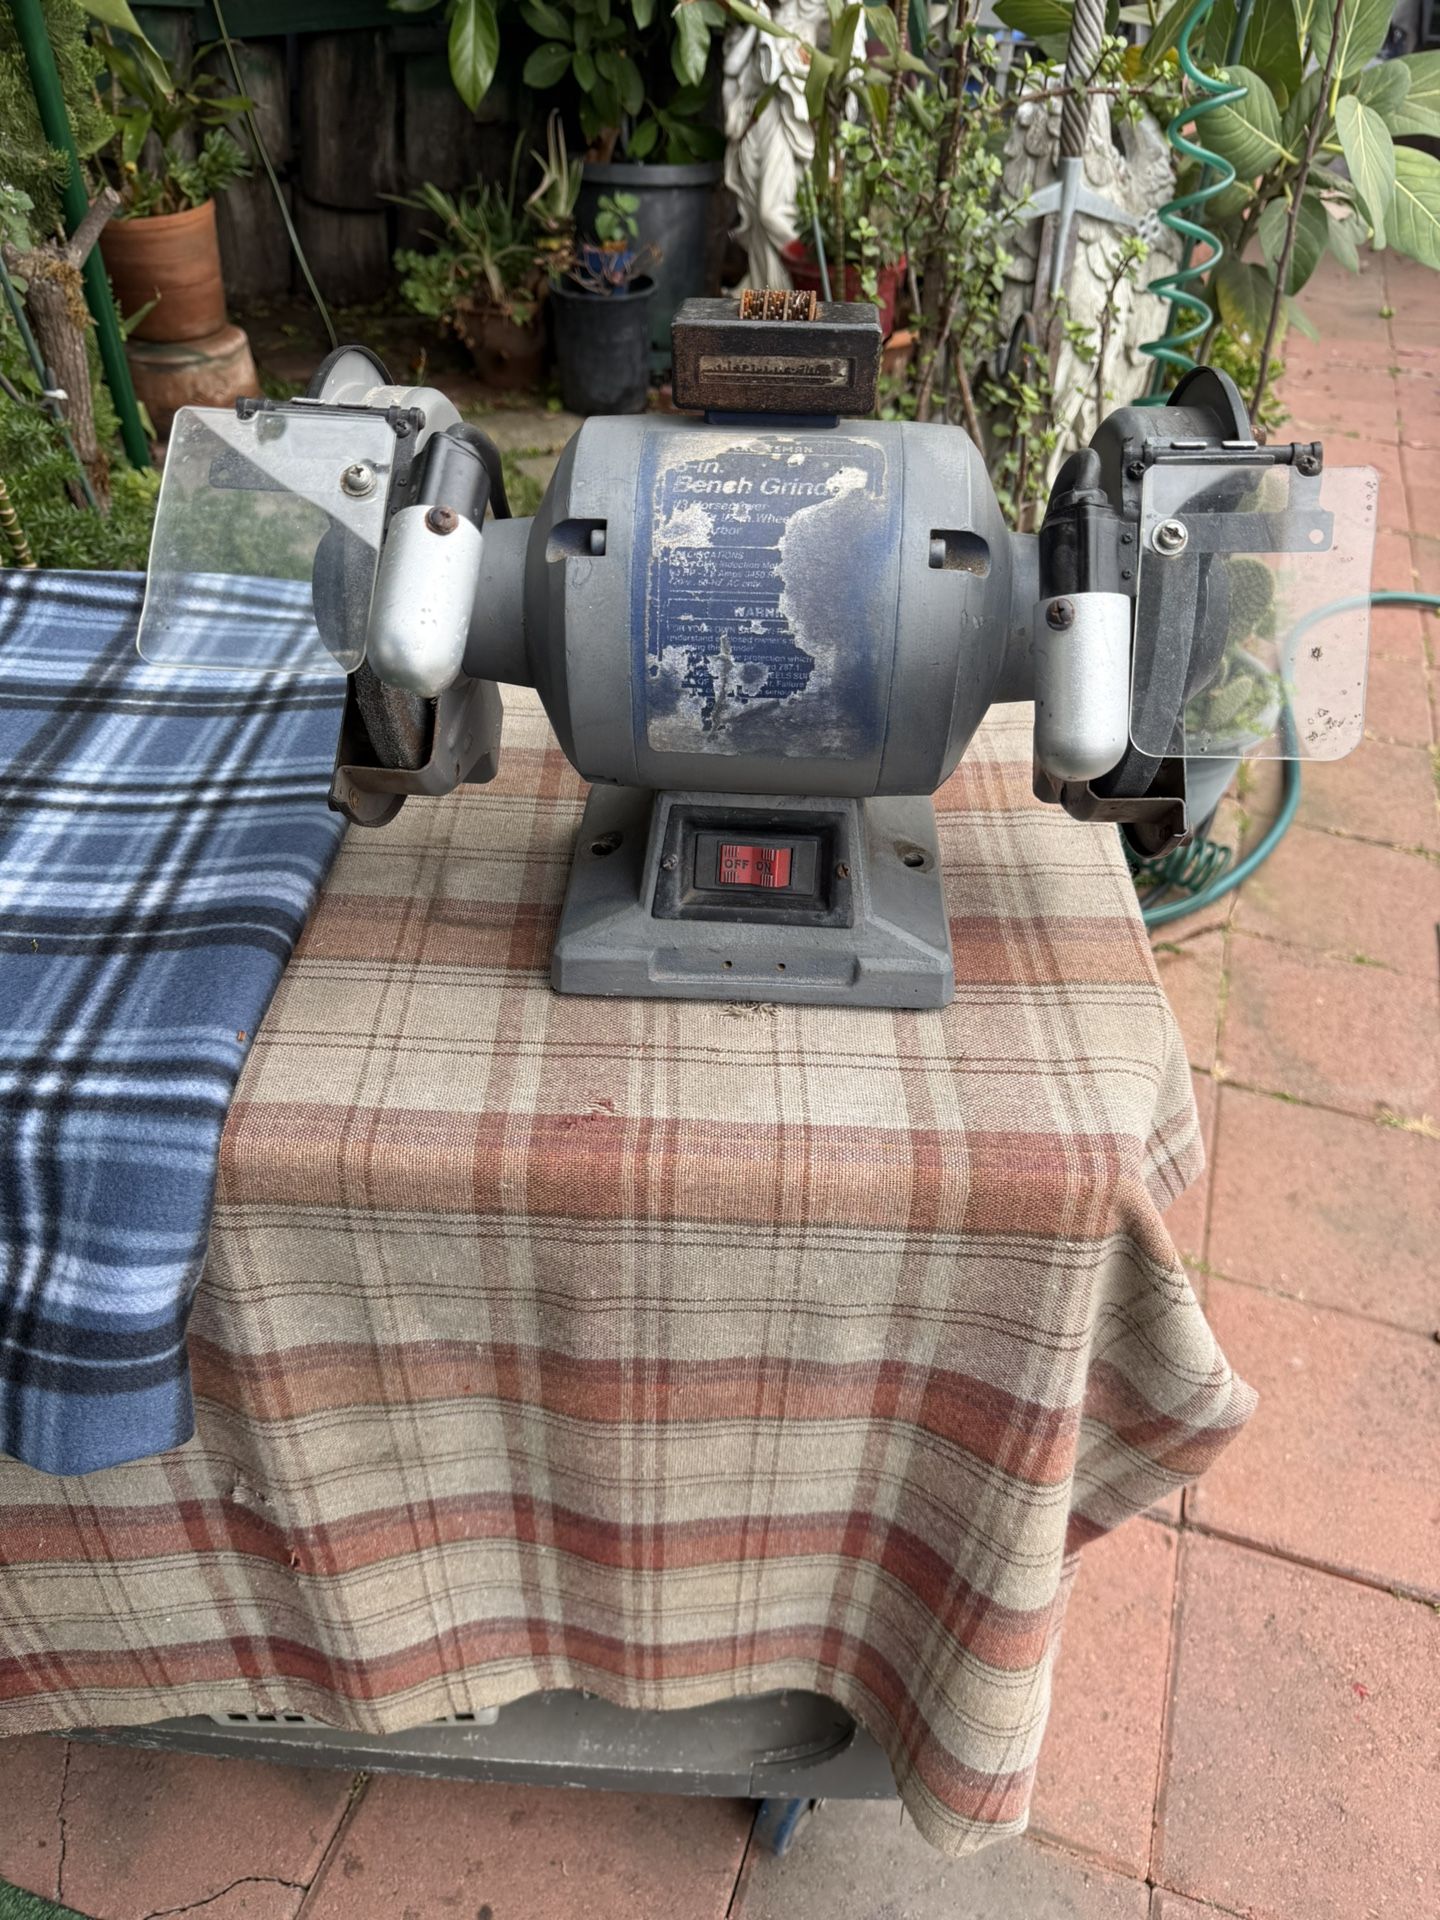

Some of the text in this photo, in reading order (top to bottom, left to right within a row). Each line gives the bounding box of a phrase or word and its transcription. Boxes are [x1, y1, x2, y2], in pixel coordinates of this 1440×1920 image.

[672, 475, 753, 494] Bench
[724, 858, 772, 873] OFF ON
